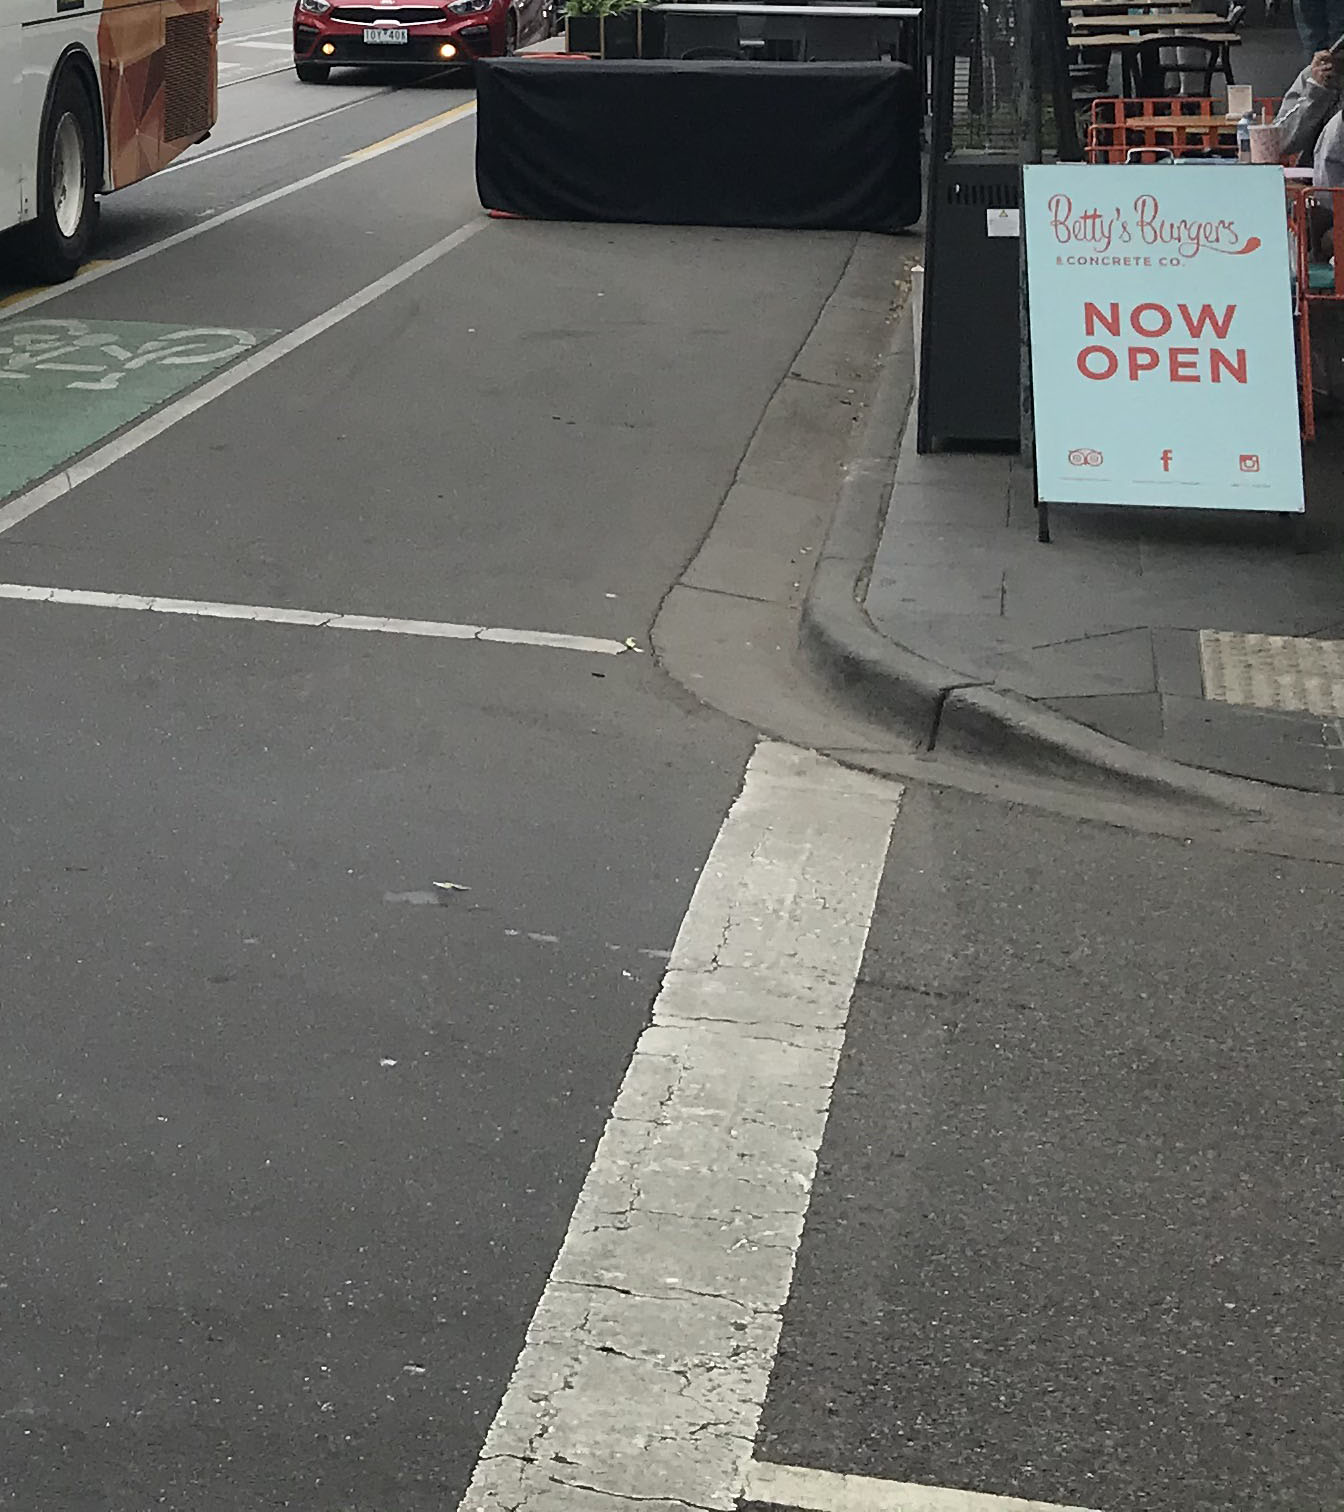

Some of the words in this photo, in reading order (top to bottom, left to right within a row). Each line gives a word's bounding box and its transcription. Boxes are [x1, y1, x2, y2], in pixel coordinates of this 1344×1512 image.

[1048, 193, 1132, 253] Betty's
[1134, 194, 1261, 258] Burgers
[1067, 255, 1152, 266] CONCRETE
[1159, 257, 1185, 267] CO.
[1084, 302, 1237, 339] NOW
[1077, 345, 1248, 384] OPEN
